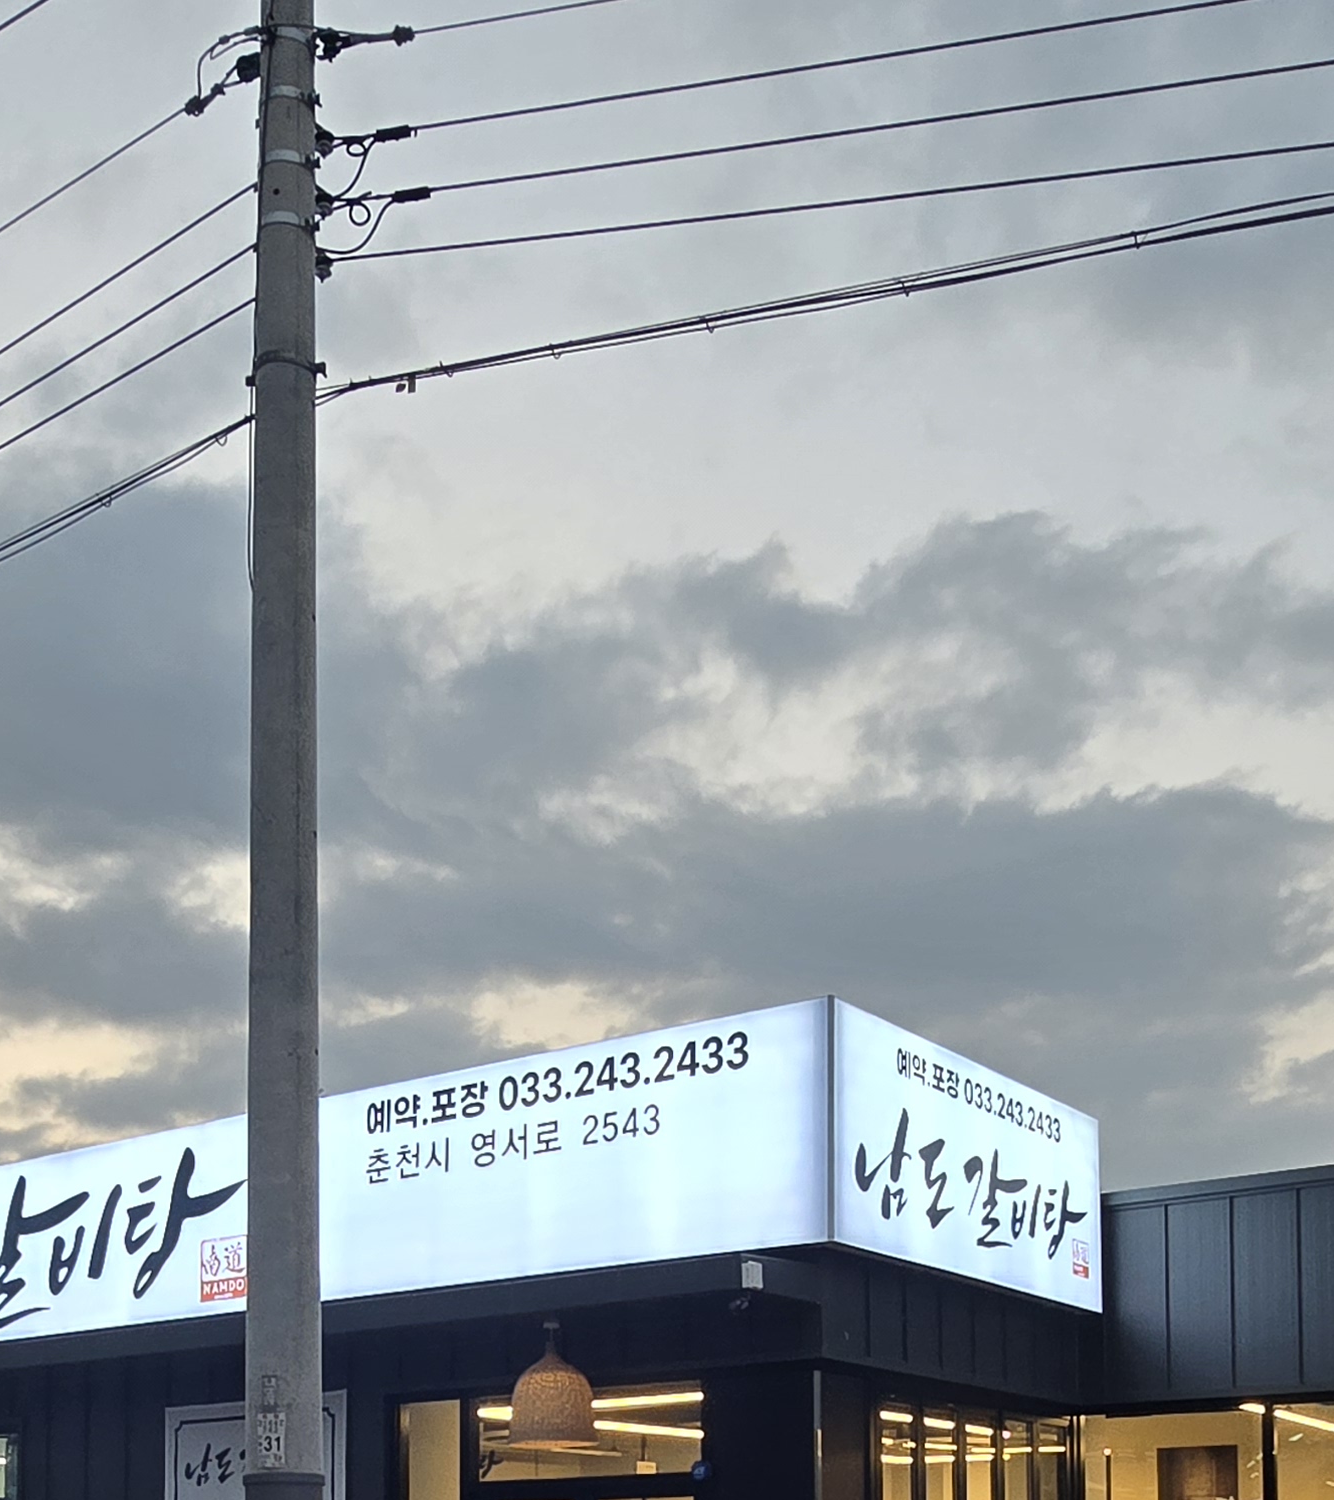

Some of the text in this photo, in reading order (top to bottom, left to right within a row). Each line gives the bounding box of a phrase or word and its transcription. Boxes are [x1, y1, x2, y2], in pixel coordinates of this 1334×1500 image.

[367, 1031, 749, 1134] 예약.포장 033.243.2433
[897, 1048, 1061, 1142] 예약.포장 033.243.2433
[366, 1104, 660, 1184] 춘천시 영서로 2543
[203, 1279, 244, 1295] NAMDO
[263, 1435, 281, 1452] 31
